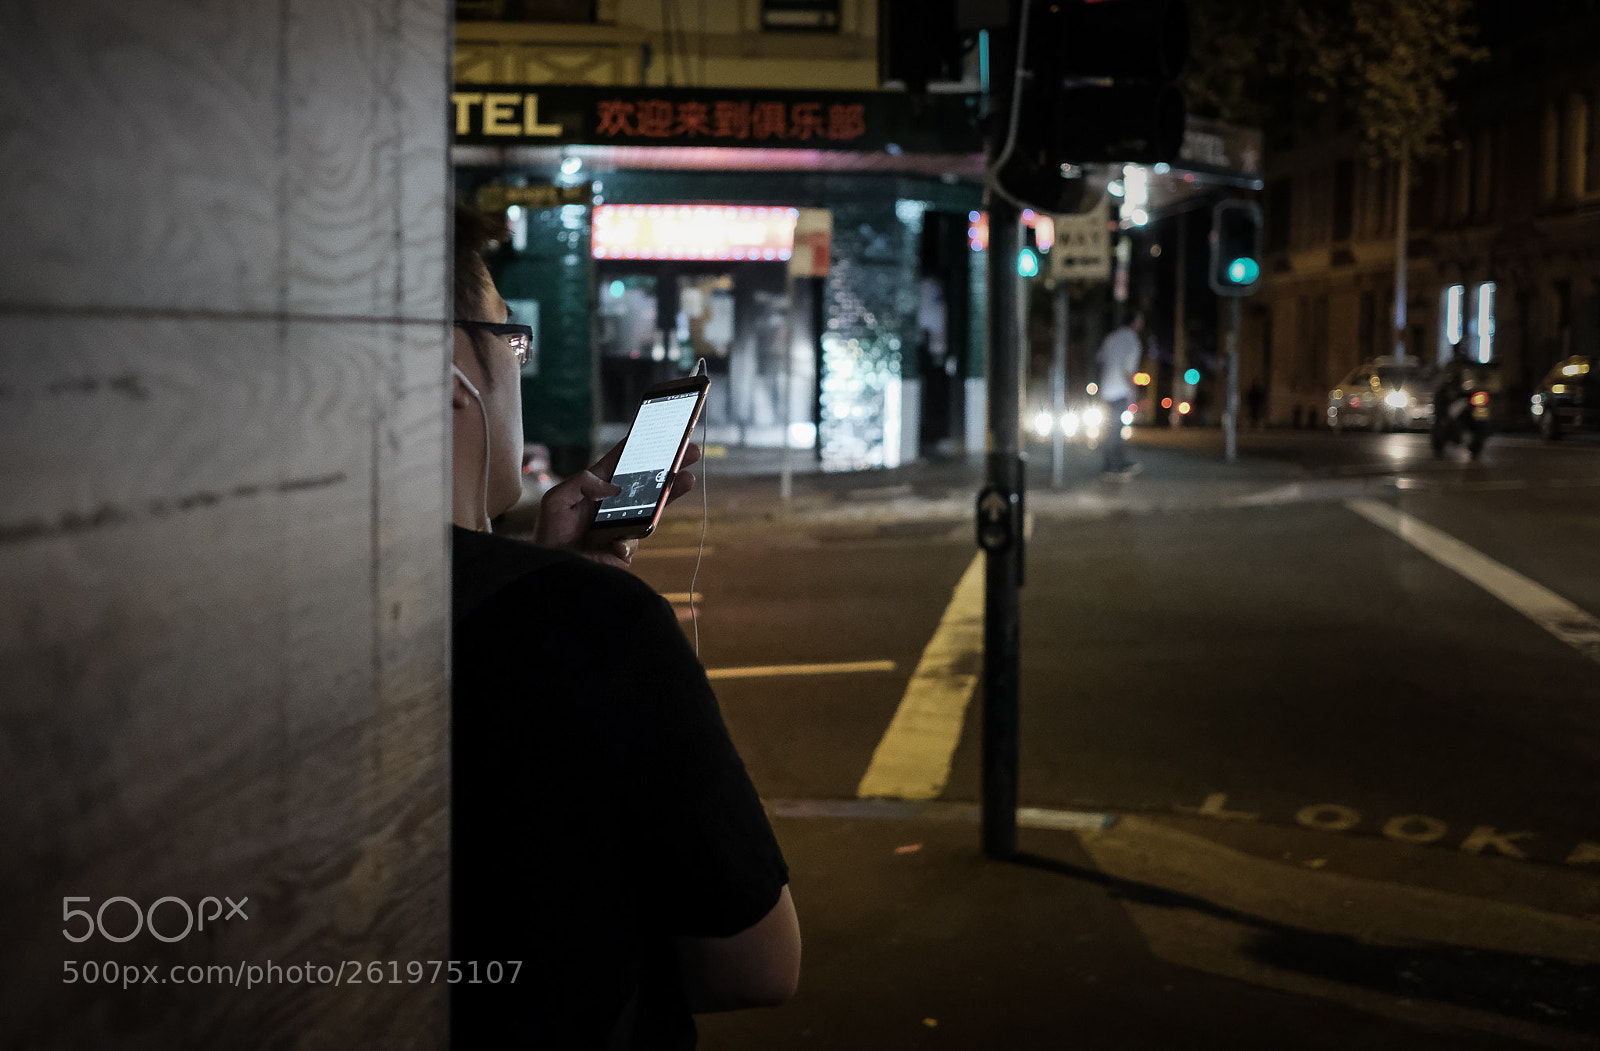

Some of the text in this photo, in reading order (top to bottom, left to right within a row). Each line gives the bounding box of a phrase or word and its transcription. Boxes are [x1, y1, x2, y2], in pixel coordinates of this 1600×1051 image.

[597, 99, 866, 141] 欢迎来到俱乐部
[1198, 793, 1535, 858] LOOK
